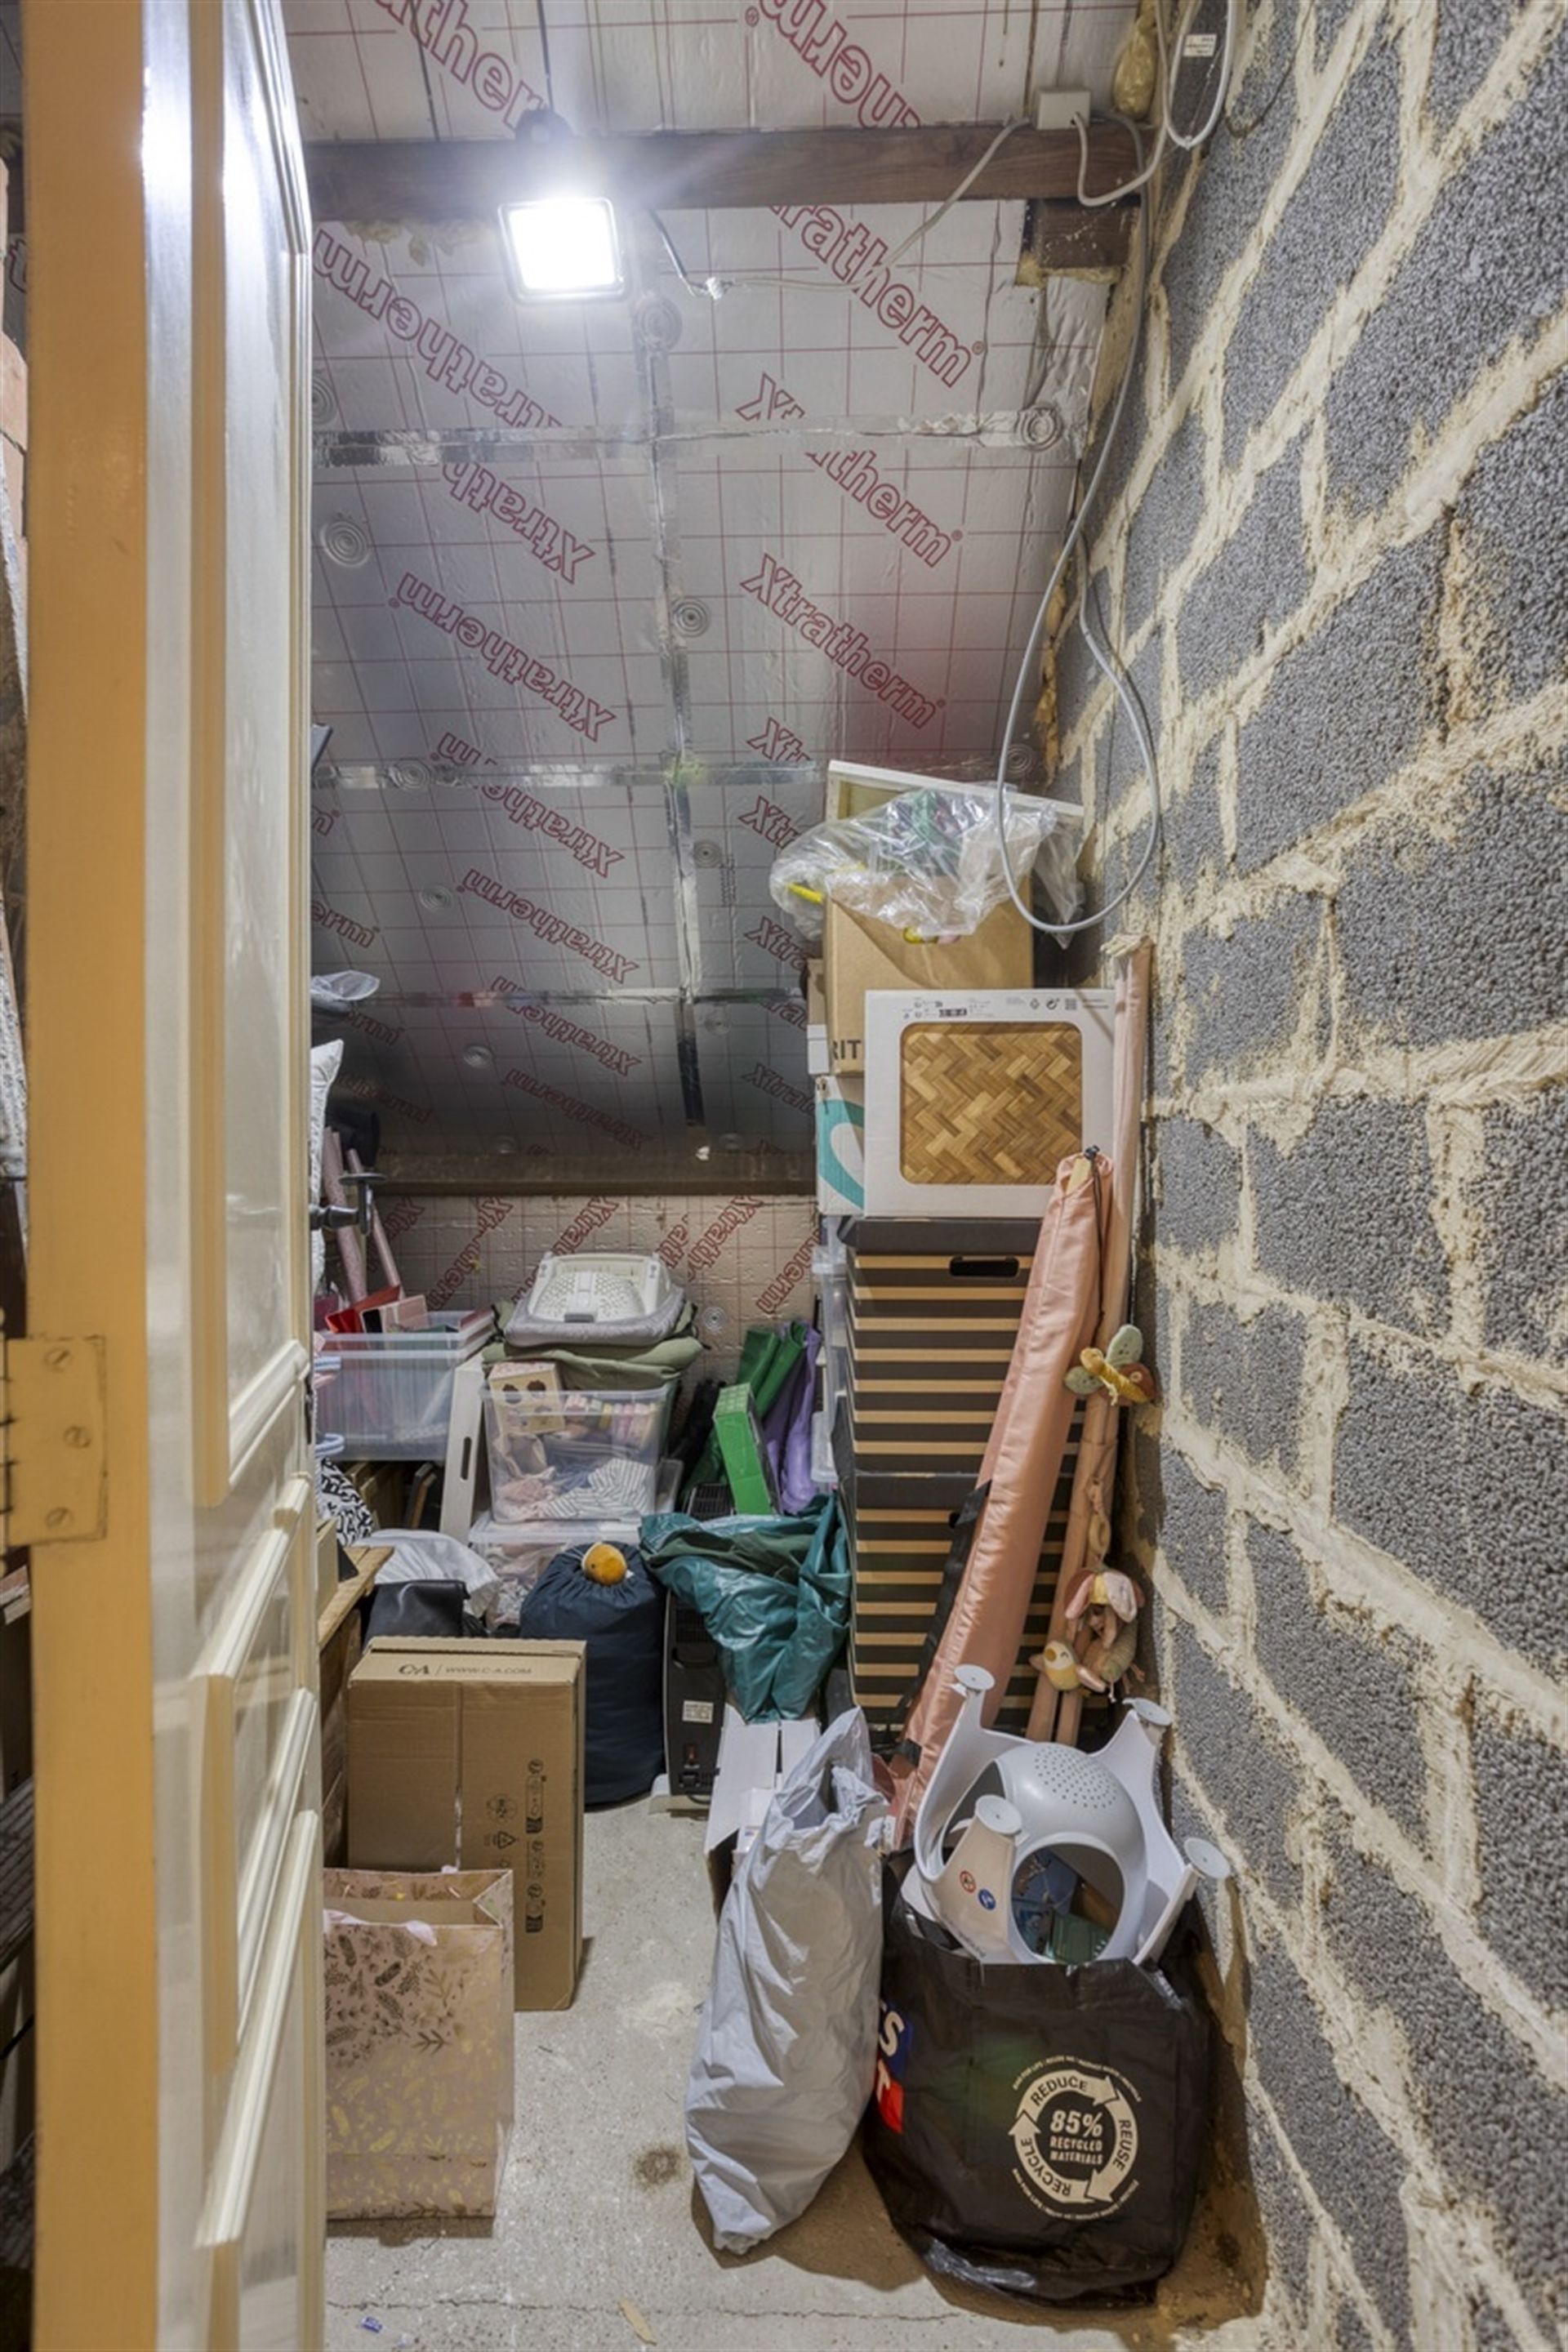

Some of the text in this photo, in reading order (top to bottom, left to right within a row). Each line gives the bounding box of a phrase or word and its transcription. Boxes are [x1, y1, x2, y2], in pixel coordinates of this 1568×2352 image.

[396, 572, 617, 742] Xtratherm
[740, 554, 937, 729] Xtratherm
[462, 869, 639, 983] Xtratherm
[1030, 2075, 1088, 2107] REDUCE
[1049, 2109, 1102, 2137] 85%
[1049, 2136, 1102, 2152] RECYCLED
[1112, 2119, 1134, 2172] REUSE
[1021, 2136, 1072, 2197] RECYCLE
[1049, 2150, 1103, 2165] MATERIALS
